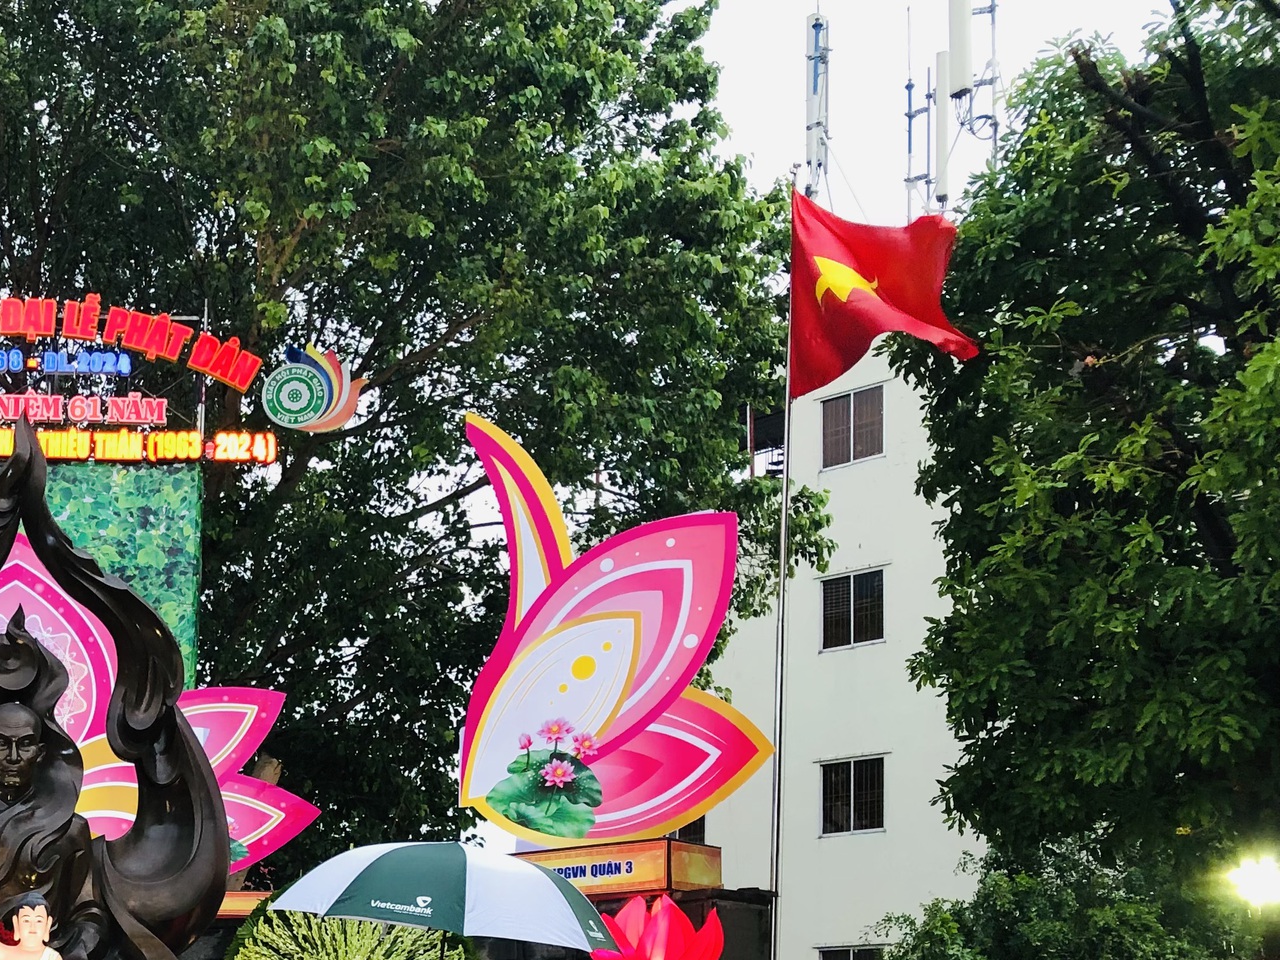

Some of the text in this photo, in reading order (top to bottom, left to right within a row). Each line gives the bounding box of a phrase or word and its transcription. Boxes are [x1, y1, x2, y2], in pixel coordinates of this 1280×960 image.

[62, 293, 102, 340] LỄ
[103, 306, 194, 362] PHẬT
[187, 331, 263, 394] ĐẢN
[267, 381, 277, 400] GIÁO
[68, 395, 103, 424] 61
[107, 391, 168, 426] NĂM
[297, 410, 315, 422] NAM
[94, 428, 144, 461] THÂN
[553, 860, 633, 880] PGVN QUẬN 3
[370, 899, 434, 915] Vietcombank
